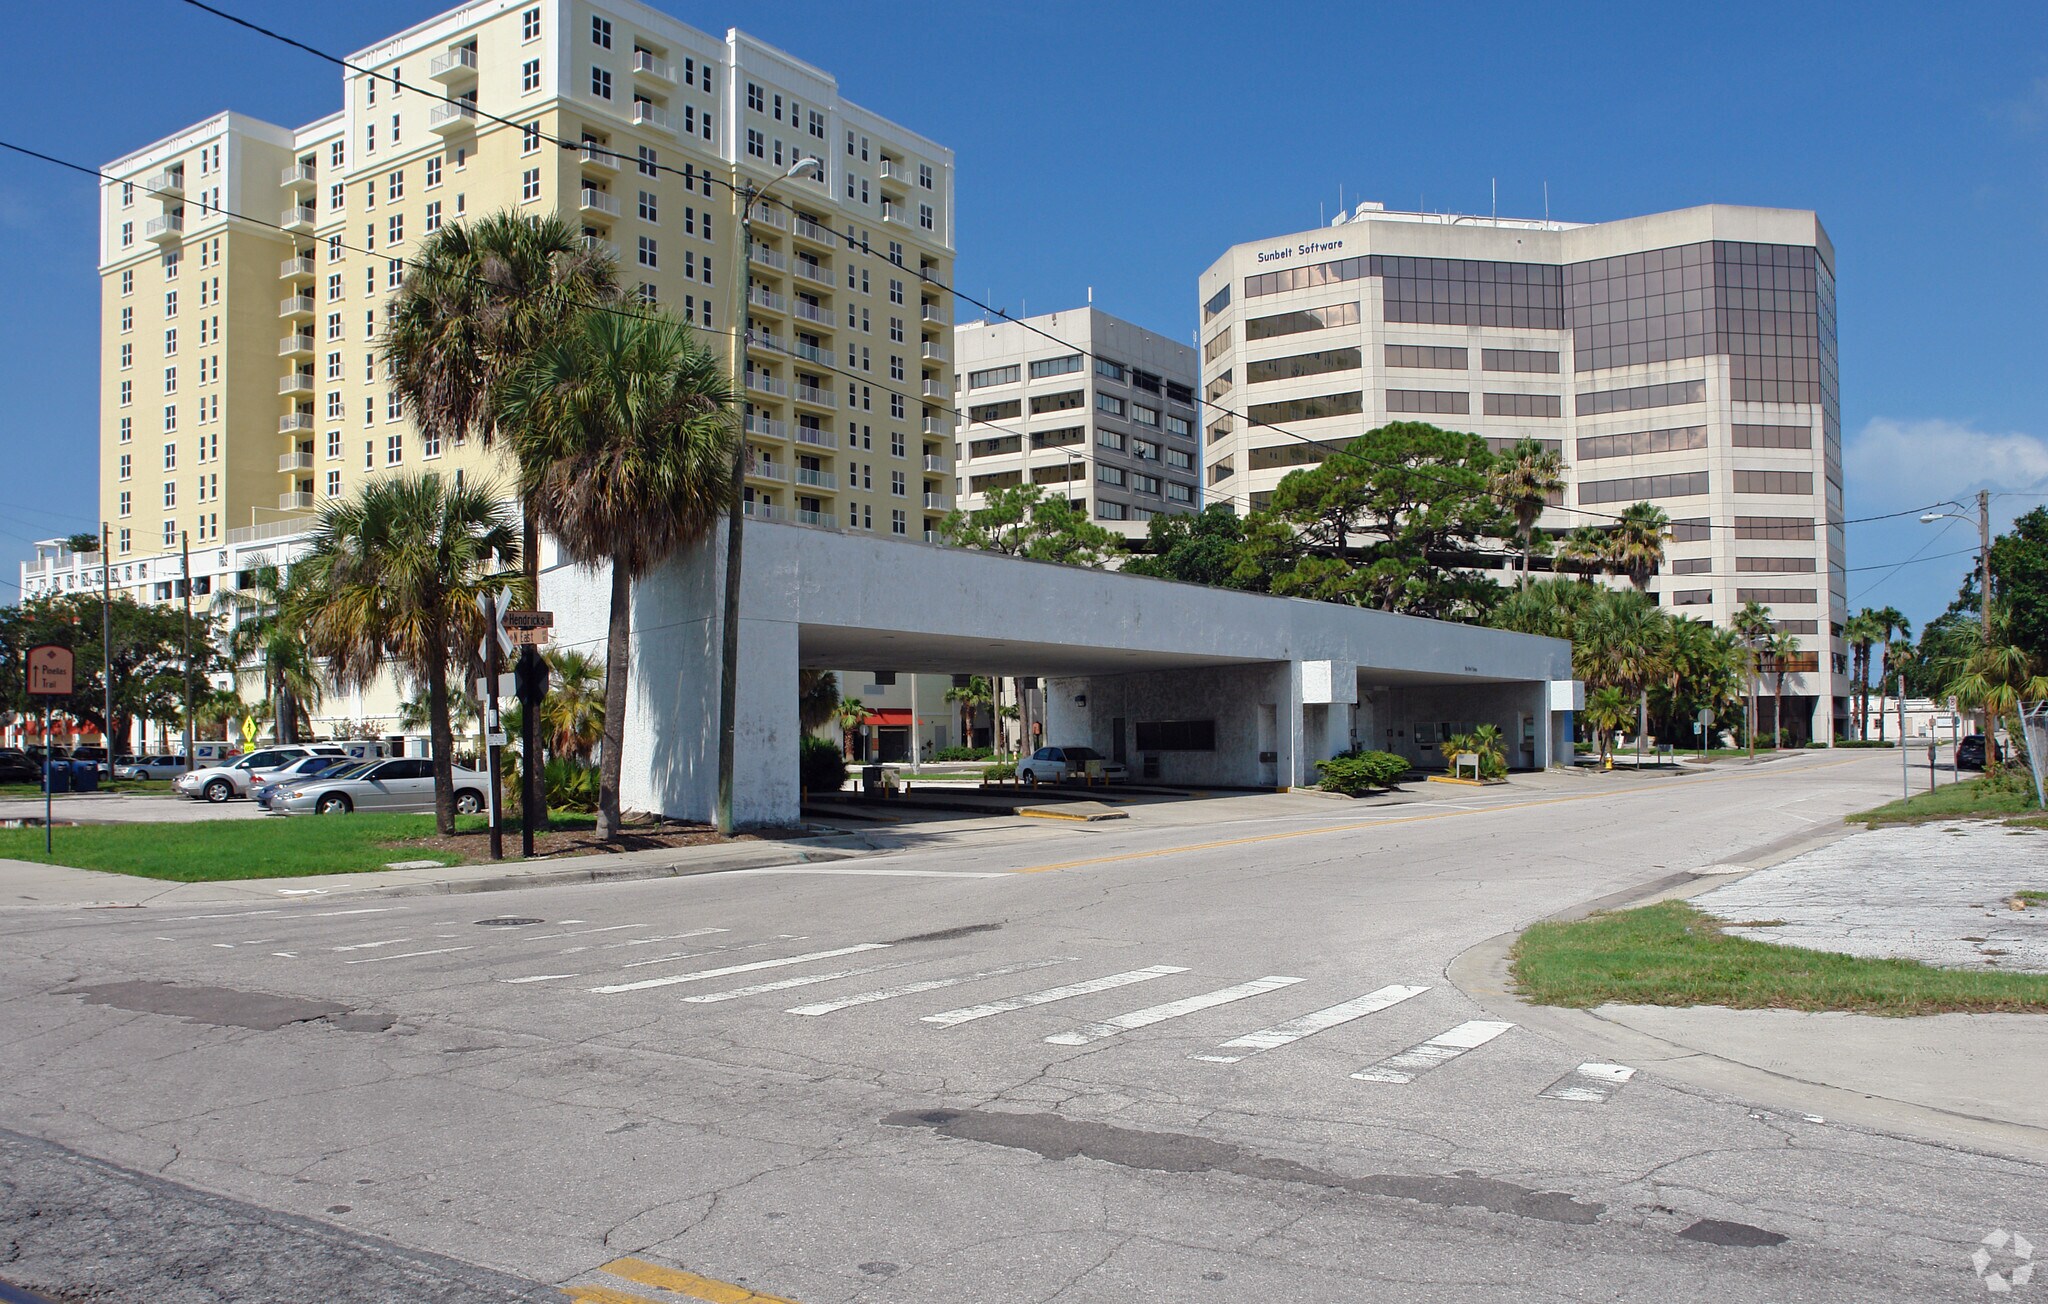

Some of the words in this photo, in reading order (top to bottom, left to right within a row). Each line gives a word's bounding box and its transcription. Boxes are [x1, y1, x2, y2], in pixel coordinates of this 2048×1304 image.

[1258, 248, 1292, 262] Sunbelt
[1298, 241, 1343, 255] Software
[509, 613, 545, 626] Hendricks
[521, 631, 533, 643] East
[42, 664, 67, 675] Pinellas
[42, 678, 56, 688] Trail
